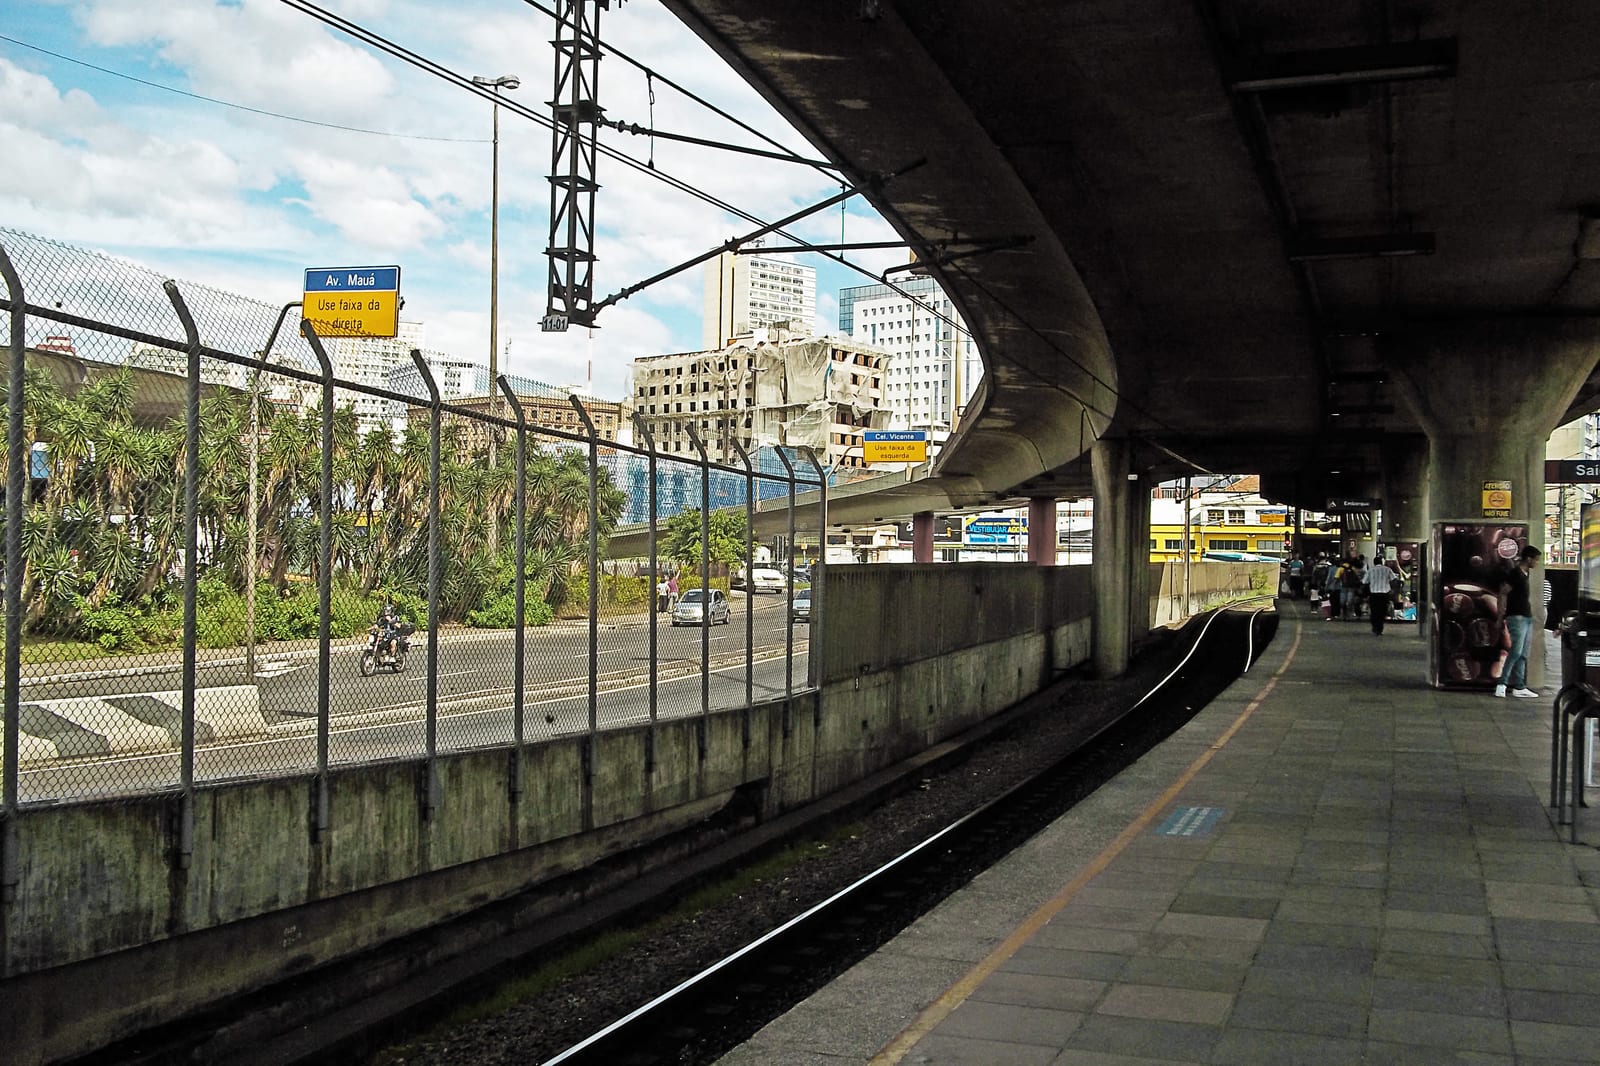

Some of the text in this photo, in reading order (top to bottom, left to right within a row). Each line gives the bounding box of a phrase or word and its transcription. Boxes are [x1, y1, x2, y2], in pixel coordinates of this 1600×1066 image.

[325, 273, 375, 287] Av. Mauá
[318, 299, 380, 311] Use faixa da
[332, 317, 362, 329] direita
[969, 524, 1007, 532] VESTIBULAR
